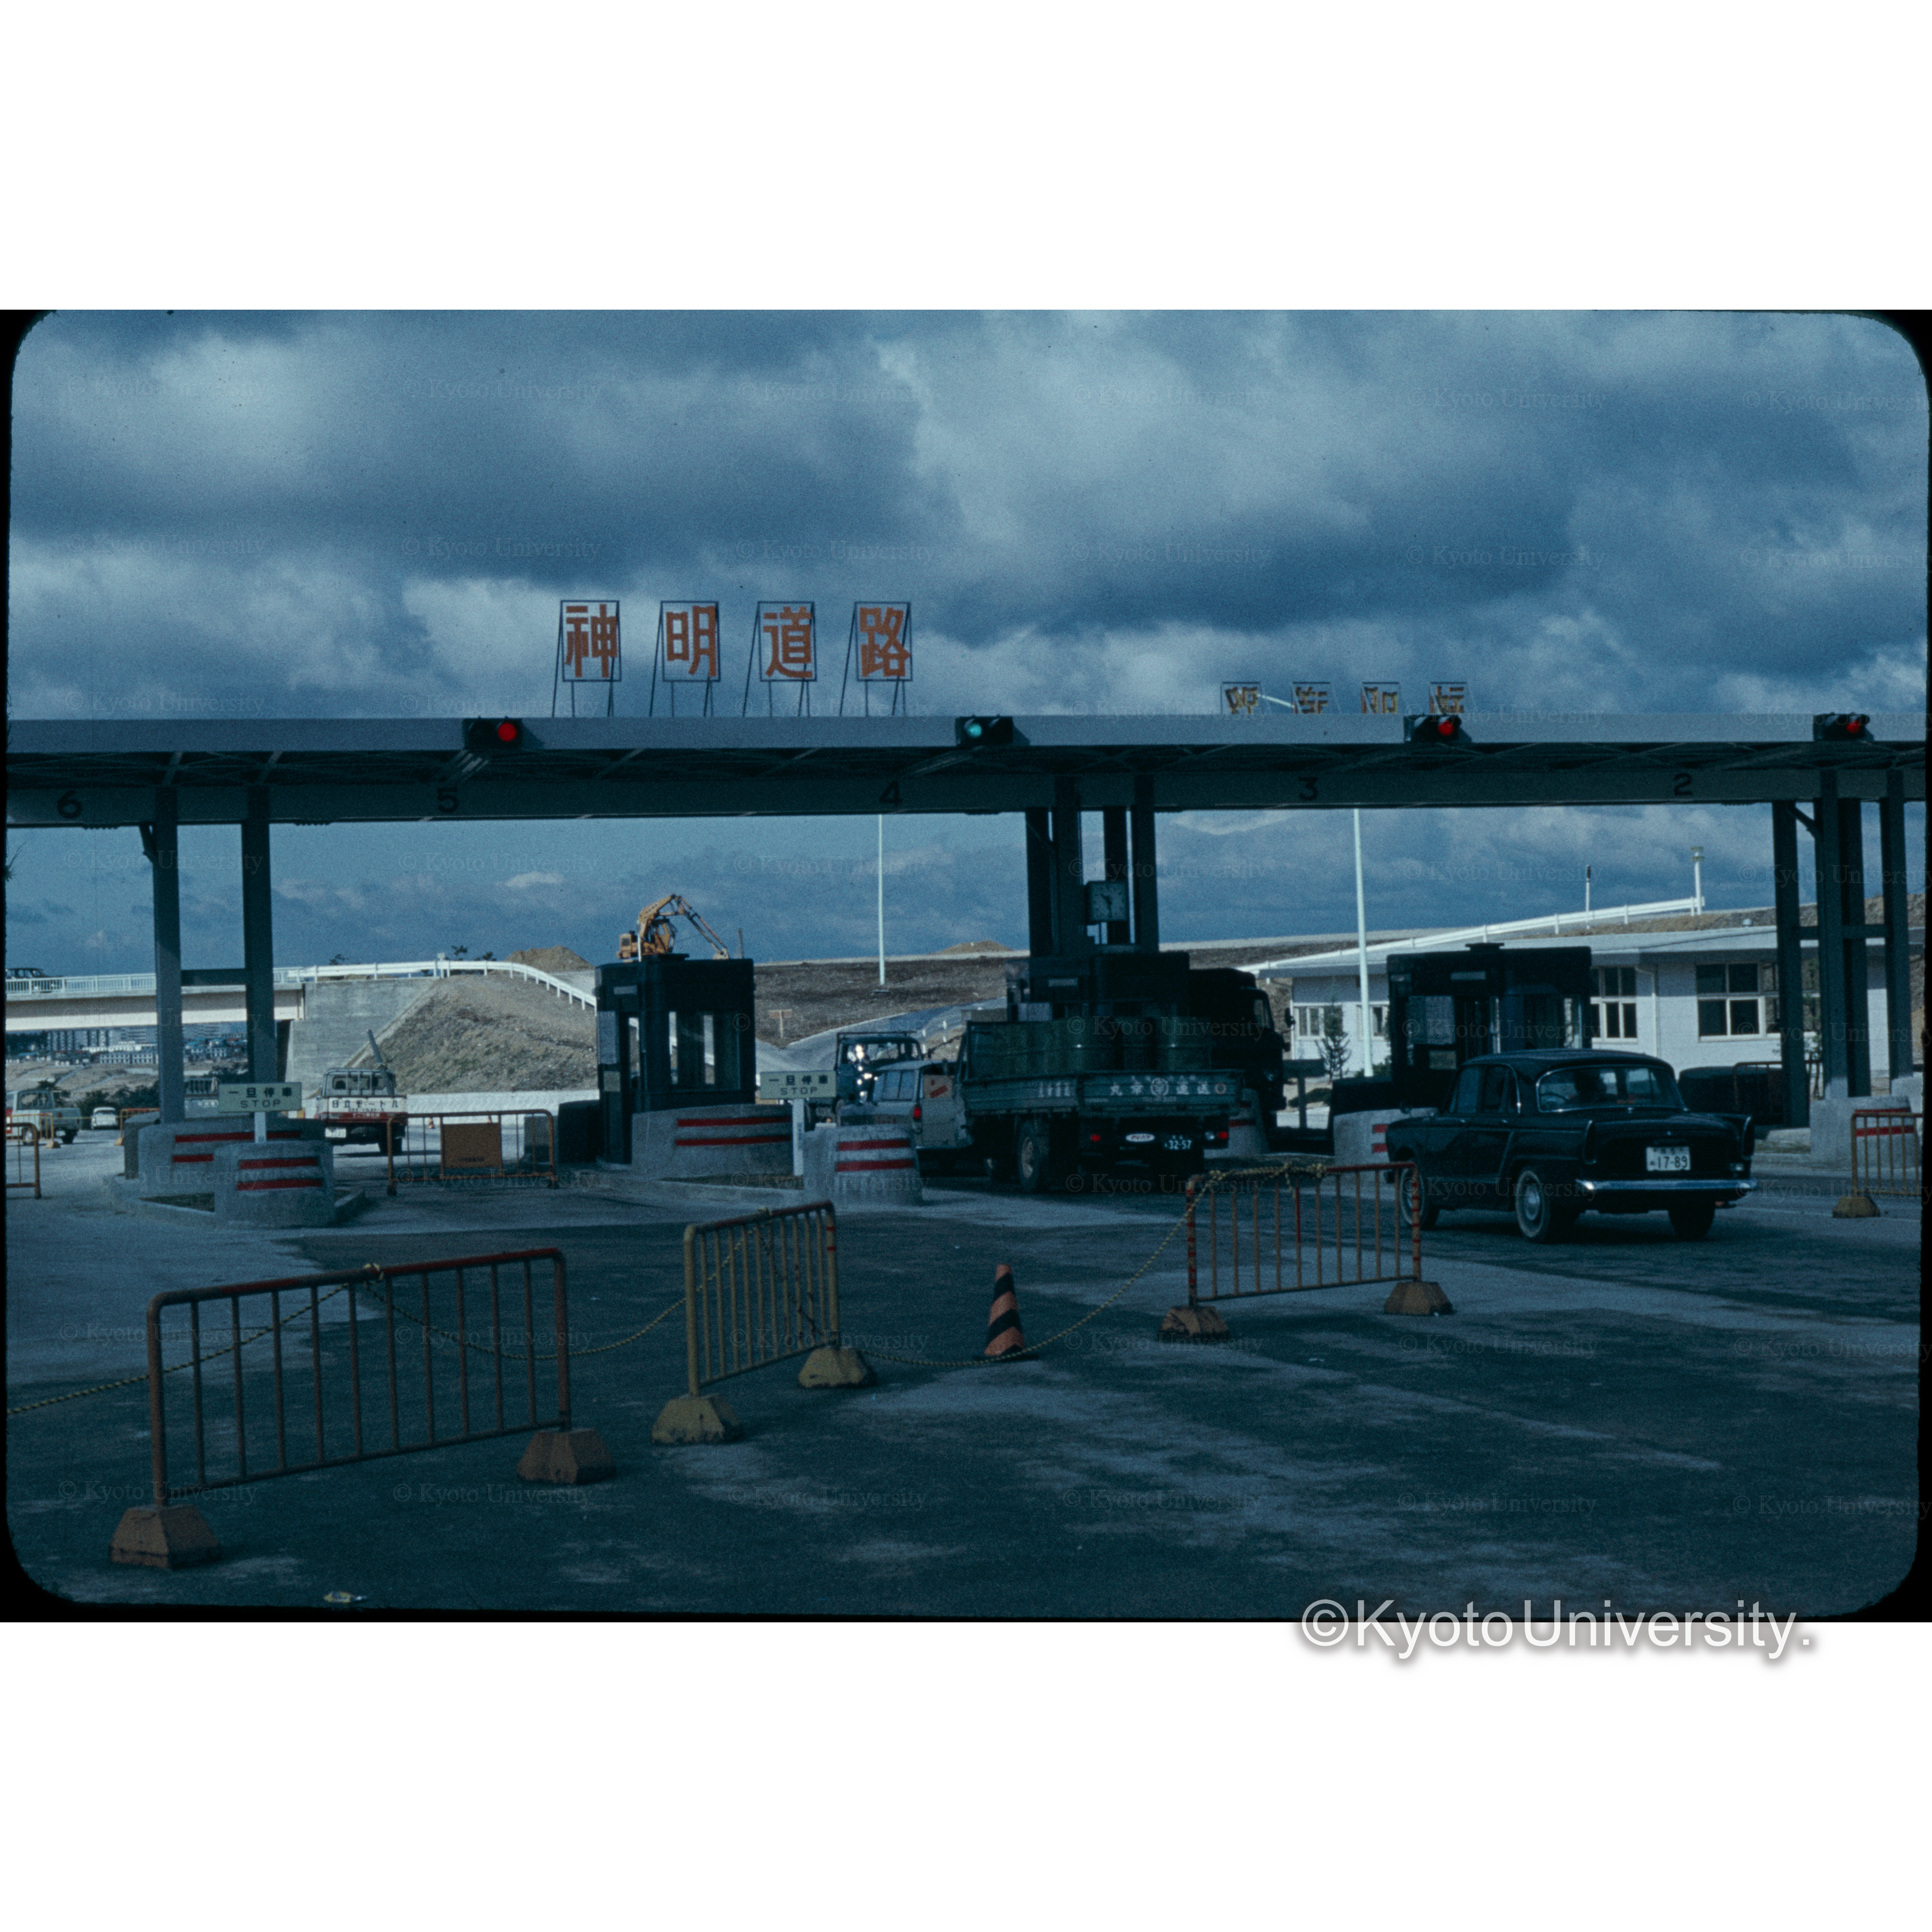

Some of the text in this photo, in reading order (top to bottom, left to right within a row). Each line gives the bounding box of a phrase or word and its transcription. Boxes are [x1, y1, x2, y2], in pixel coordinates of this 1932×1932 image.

[565, 603, 911, 678] 神明道路
[1299, 777, 1318, 801] 3
[1674, 773, 1693, 795] 2
[437, 787, 458, 813] 5
[879, 781, 903, 807] 4
[57, 791, 83, 819] 6
[769, 1075, 828, 1086] 一旦停車
[228, 1087, 292, 1097] 一旦停車
[780, 1086, 818, 1095] STOP
[240, 1099, 281, 1108] STOP
[1168, 1139, 1192, 1150] 32-57
[1658, 1155, 1688, 1168] 17-89
